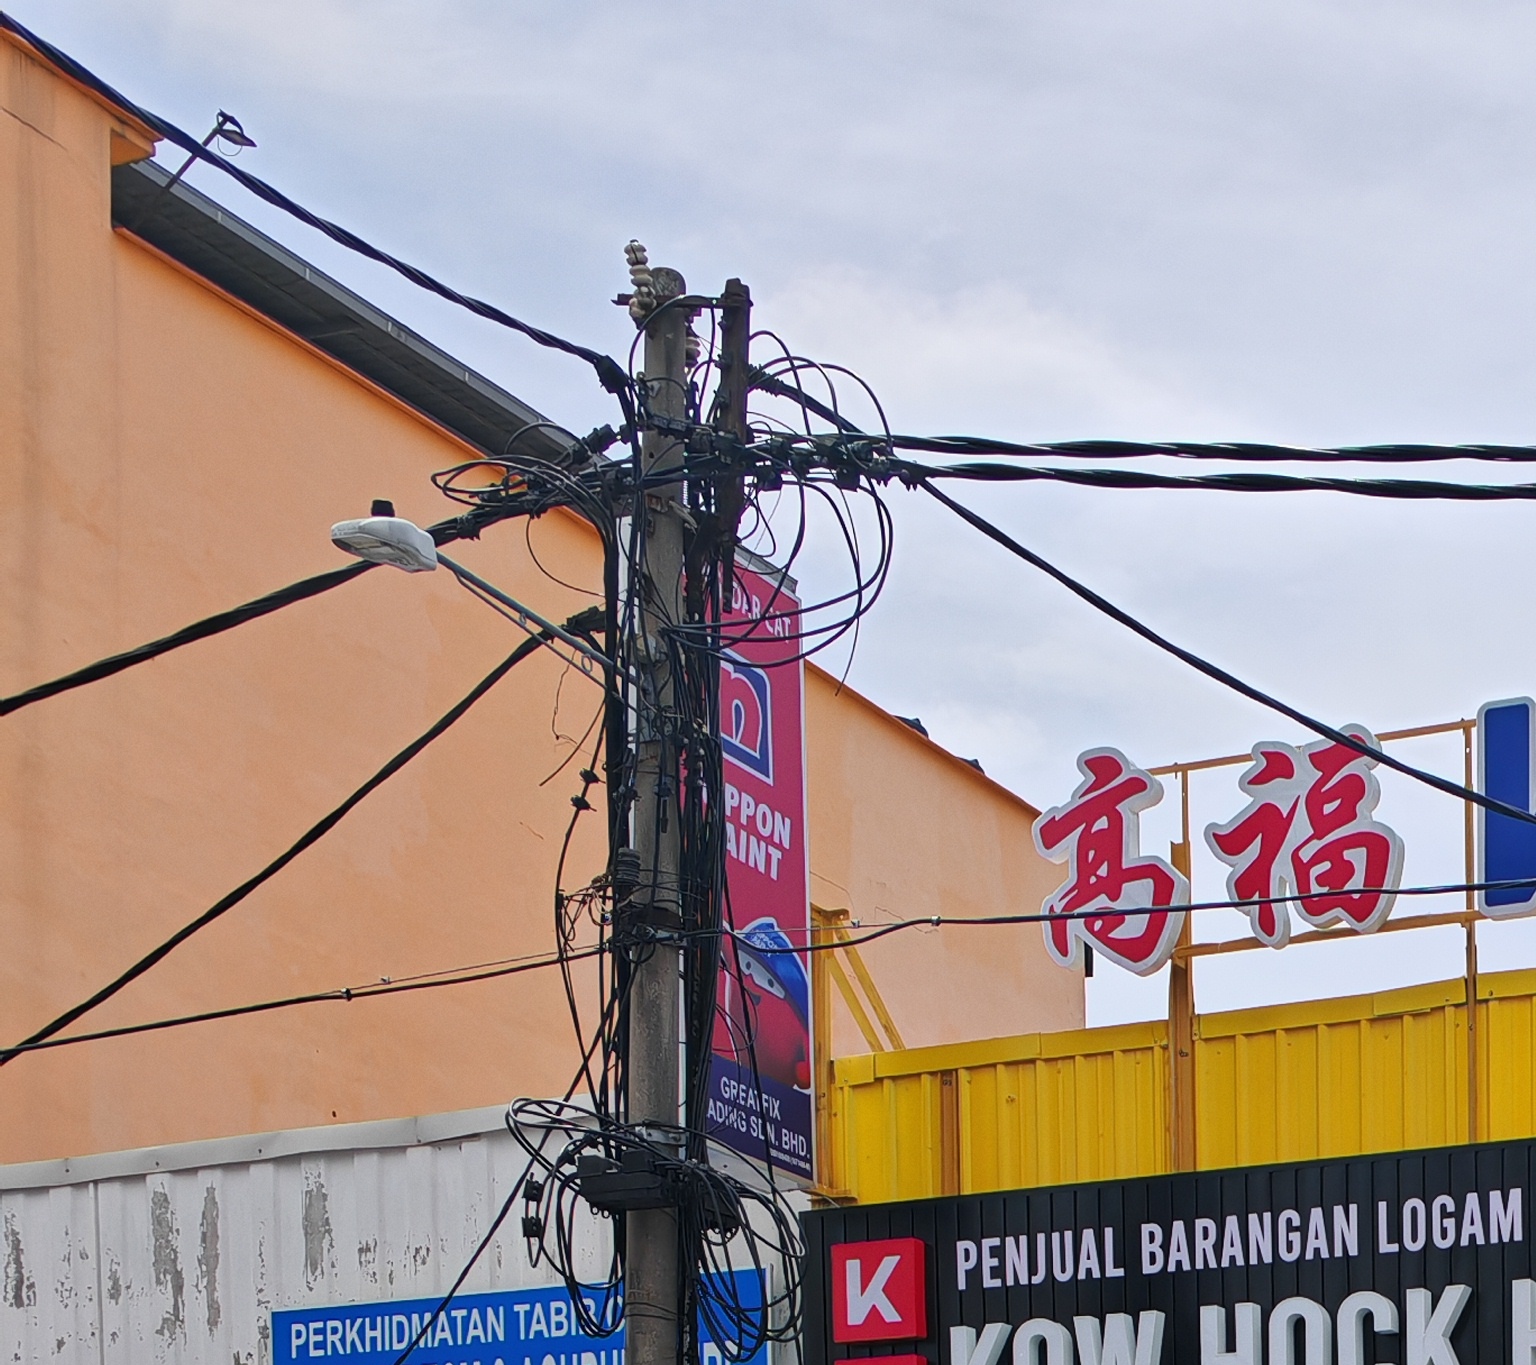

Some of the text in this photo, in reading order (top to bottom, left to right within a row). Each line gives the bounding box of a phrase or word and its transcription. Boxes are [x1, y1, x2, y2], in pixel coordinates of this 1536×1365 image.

[725, 782, 791, 849] PPON
[726, 821, 782, 881] AINT
[1033, 725, 1405, 976] 高福
[707, 1098, 747, 1132] ADING
[782, 1129, 811, 1158] BHD.
[955, 1187, 1523, 1291] PENJUAL BARANGAN LOGAM
[847, 1254, 903, 1327] K
[291, 1305, 504, 1359] PERKHIDMATAN
